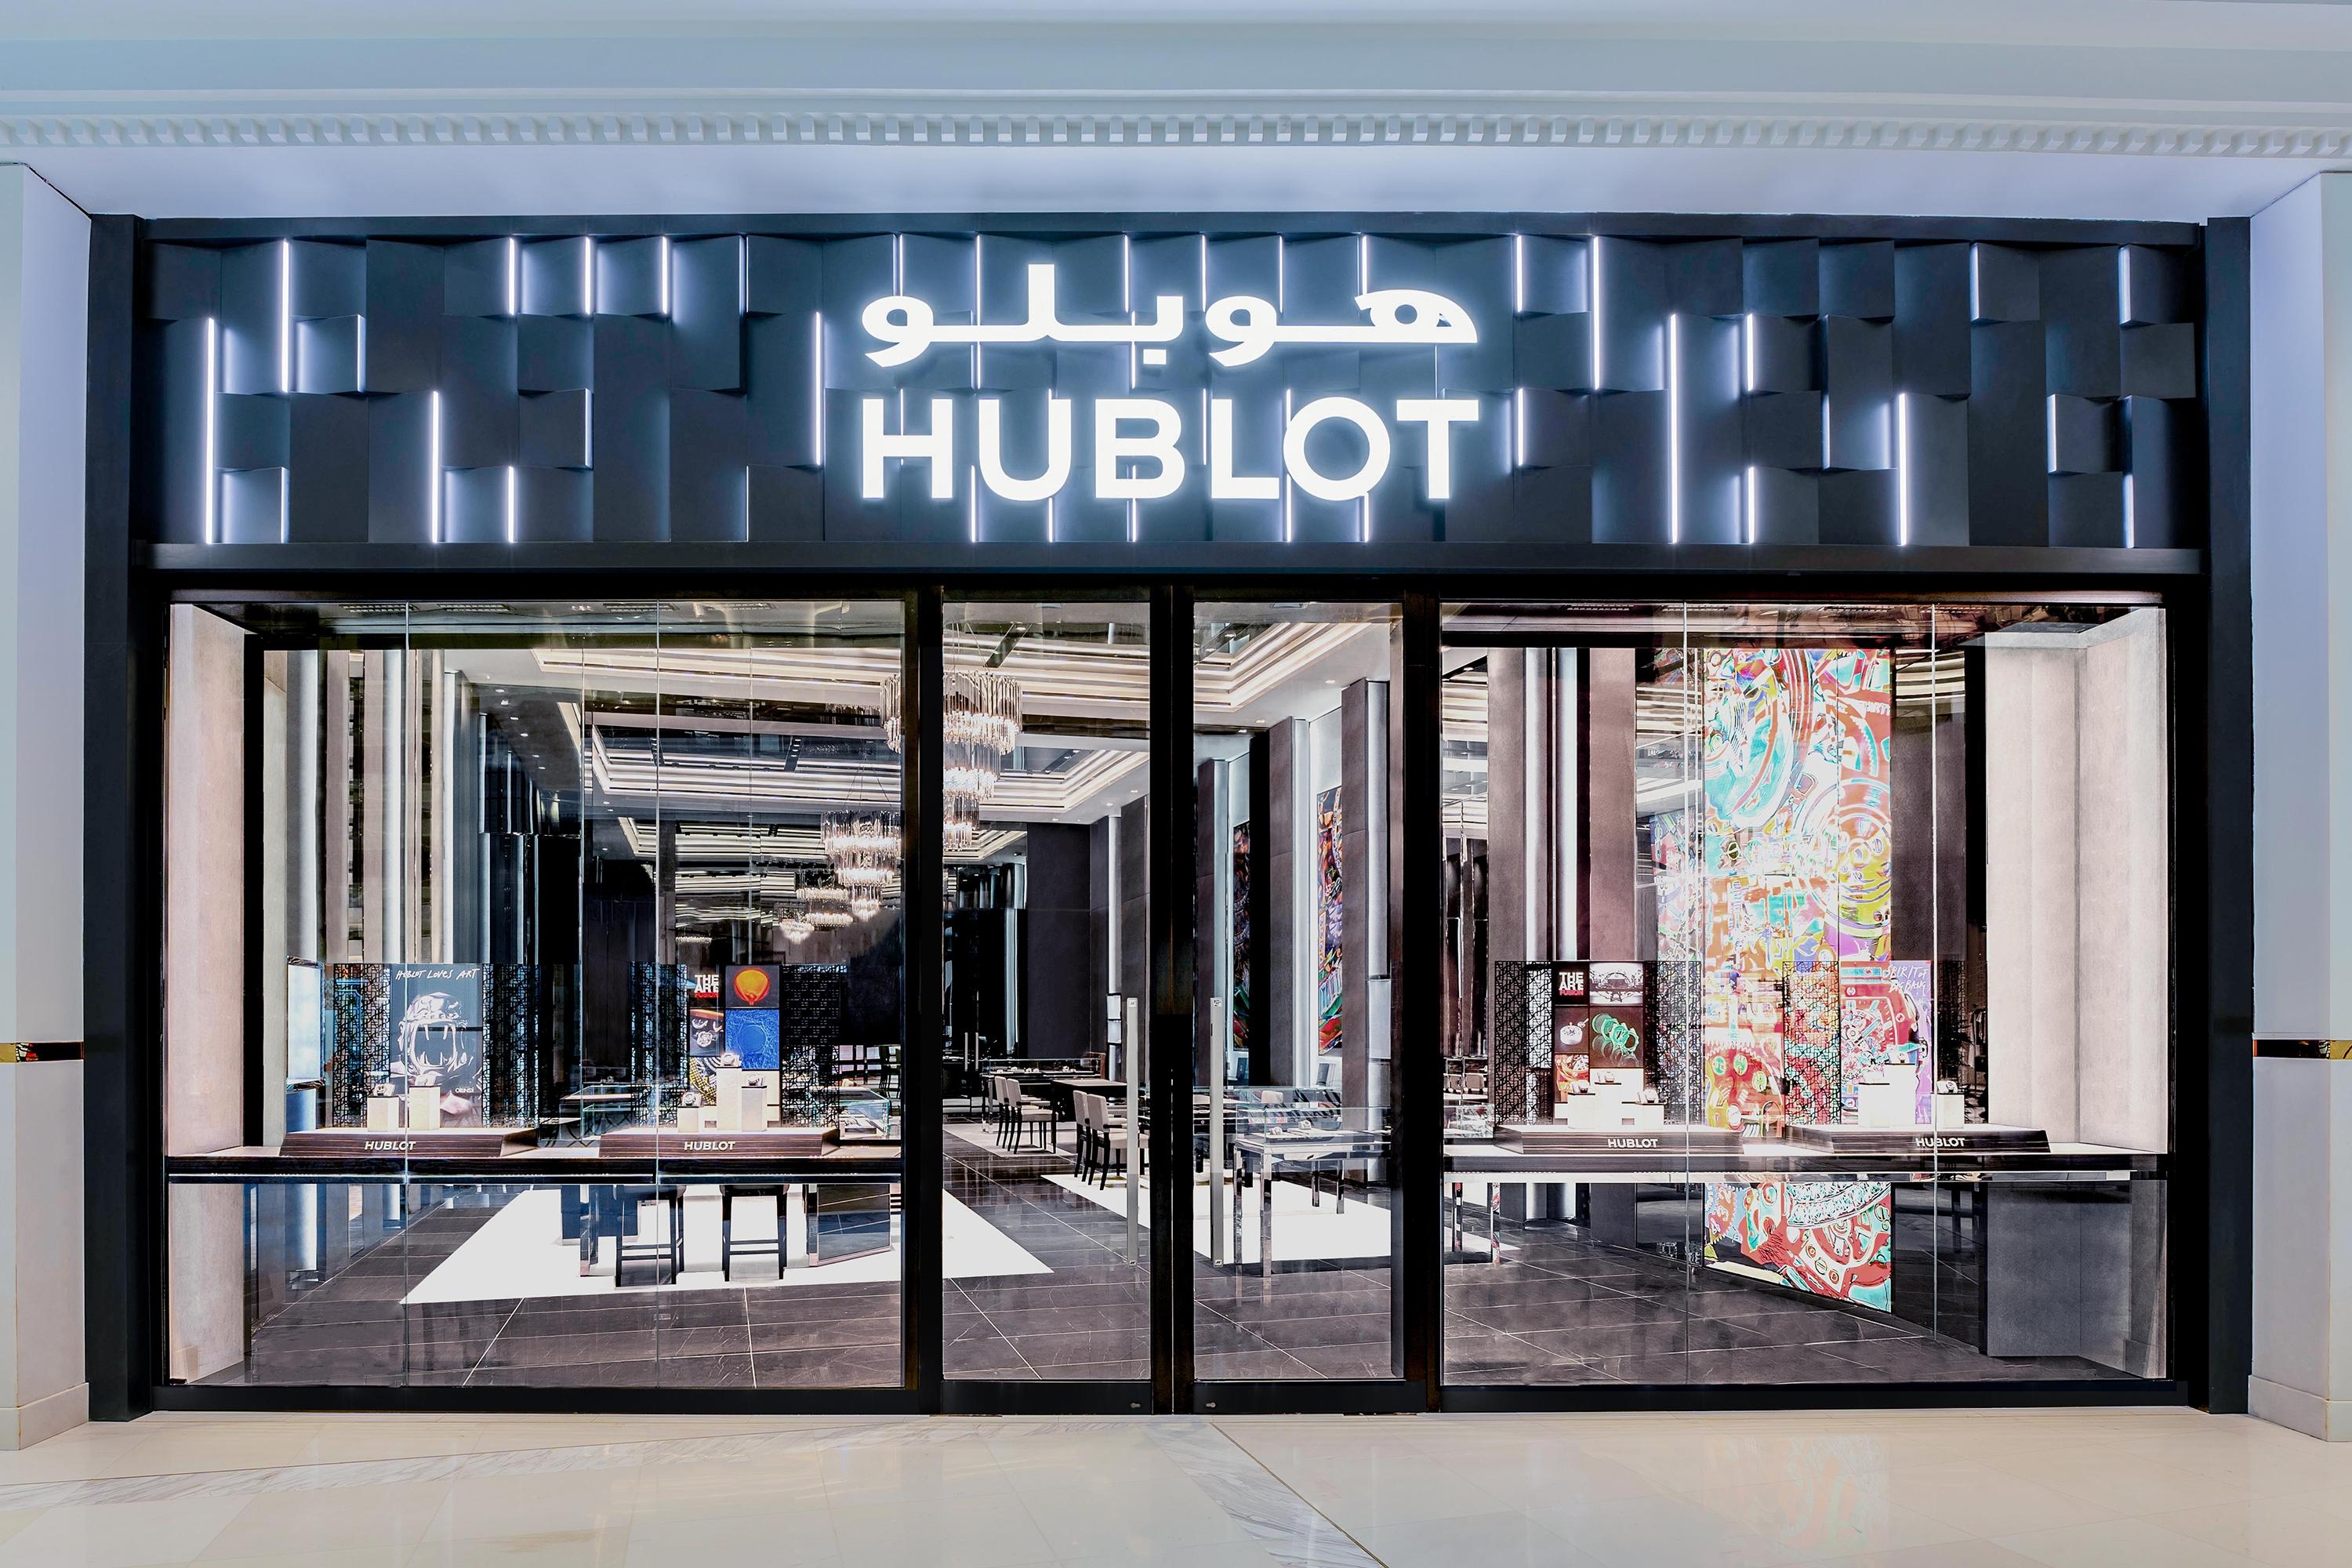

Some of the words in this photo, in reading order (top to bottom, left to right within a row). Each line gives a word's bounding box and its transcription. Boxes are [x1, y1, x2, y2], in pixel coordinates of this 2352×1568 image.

[862, 263, 1478, 368] هوبلو
[862, 397, 1479, 501] HUBLOT
[456, 968, 480, 980] ART
[1559, 971, 1584, 983] THE
[694, 975, 719, 985] THE
[364, 1141, 416, 1151] HUBLOT
[684, 1141, 736, 1151] HUBLOT
[1607, 1138, 1658, 1149] HUBLOT
[1915, 1137, 1965, 1147] HUBLOT
